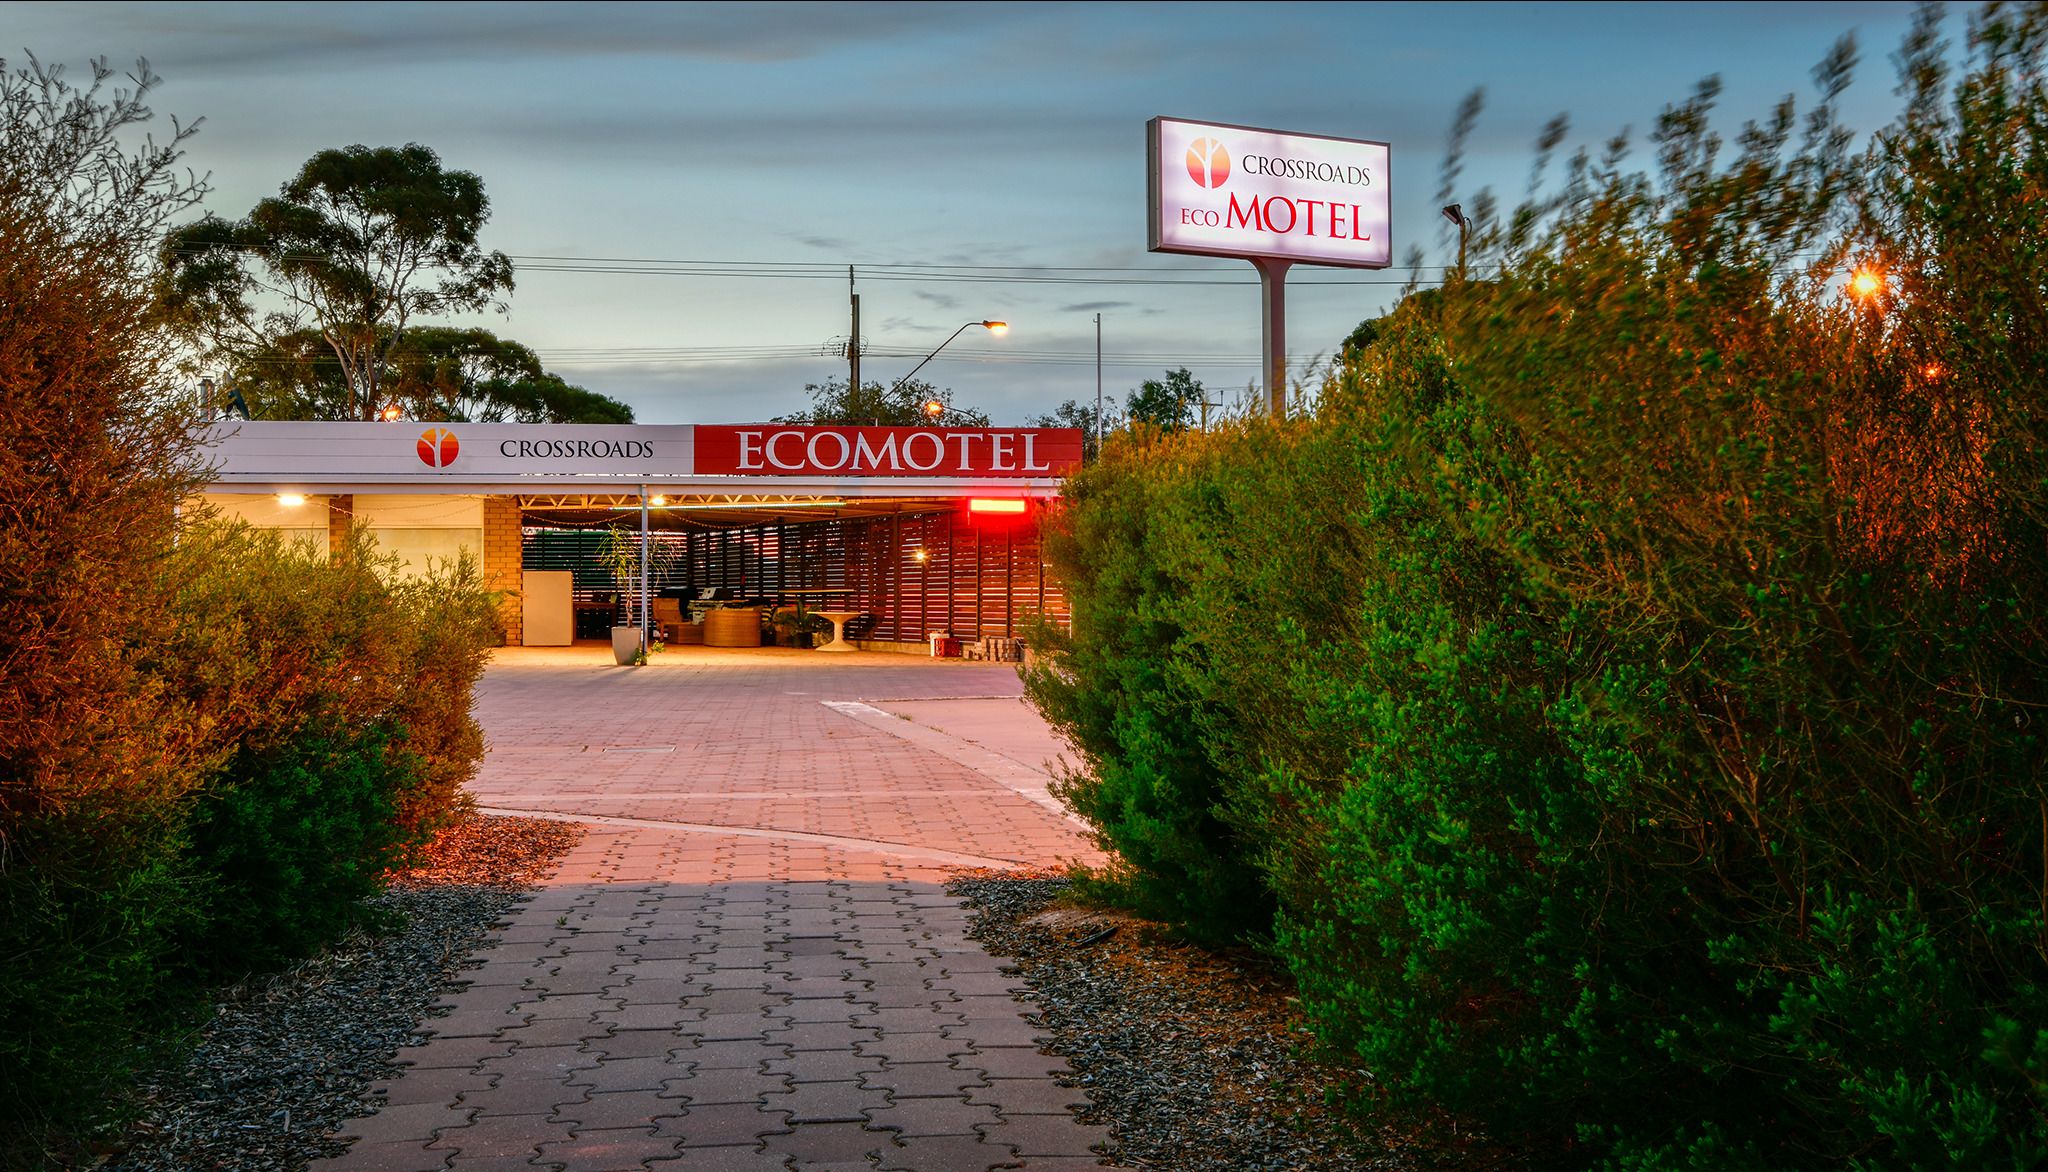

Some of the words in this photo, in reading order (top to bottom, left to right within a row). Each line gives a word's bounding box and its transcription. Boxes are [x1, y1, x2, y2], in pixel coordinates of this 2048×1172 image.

[1242, 154, 1371, 187] CROSSROADS
[1180, 207, 1220, 228] ECO
[1223, 191, 1372, 242] MOTEL
[499, 439, 654, 459] CROSSROADS
[734, 431, 1050, 471] ECOMOTEL
